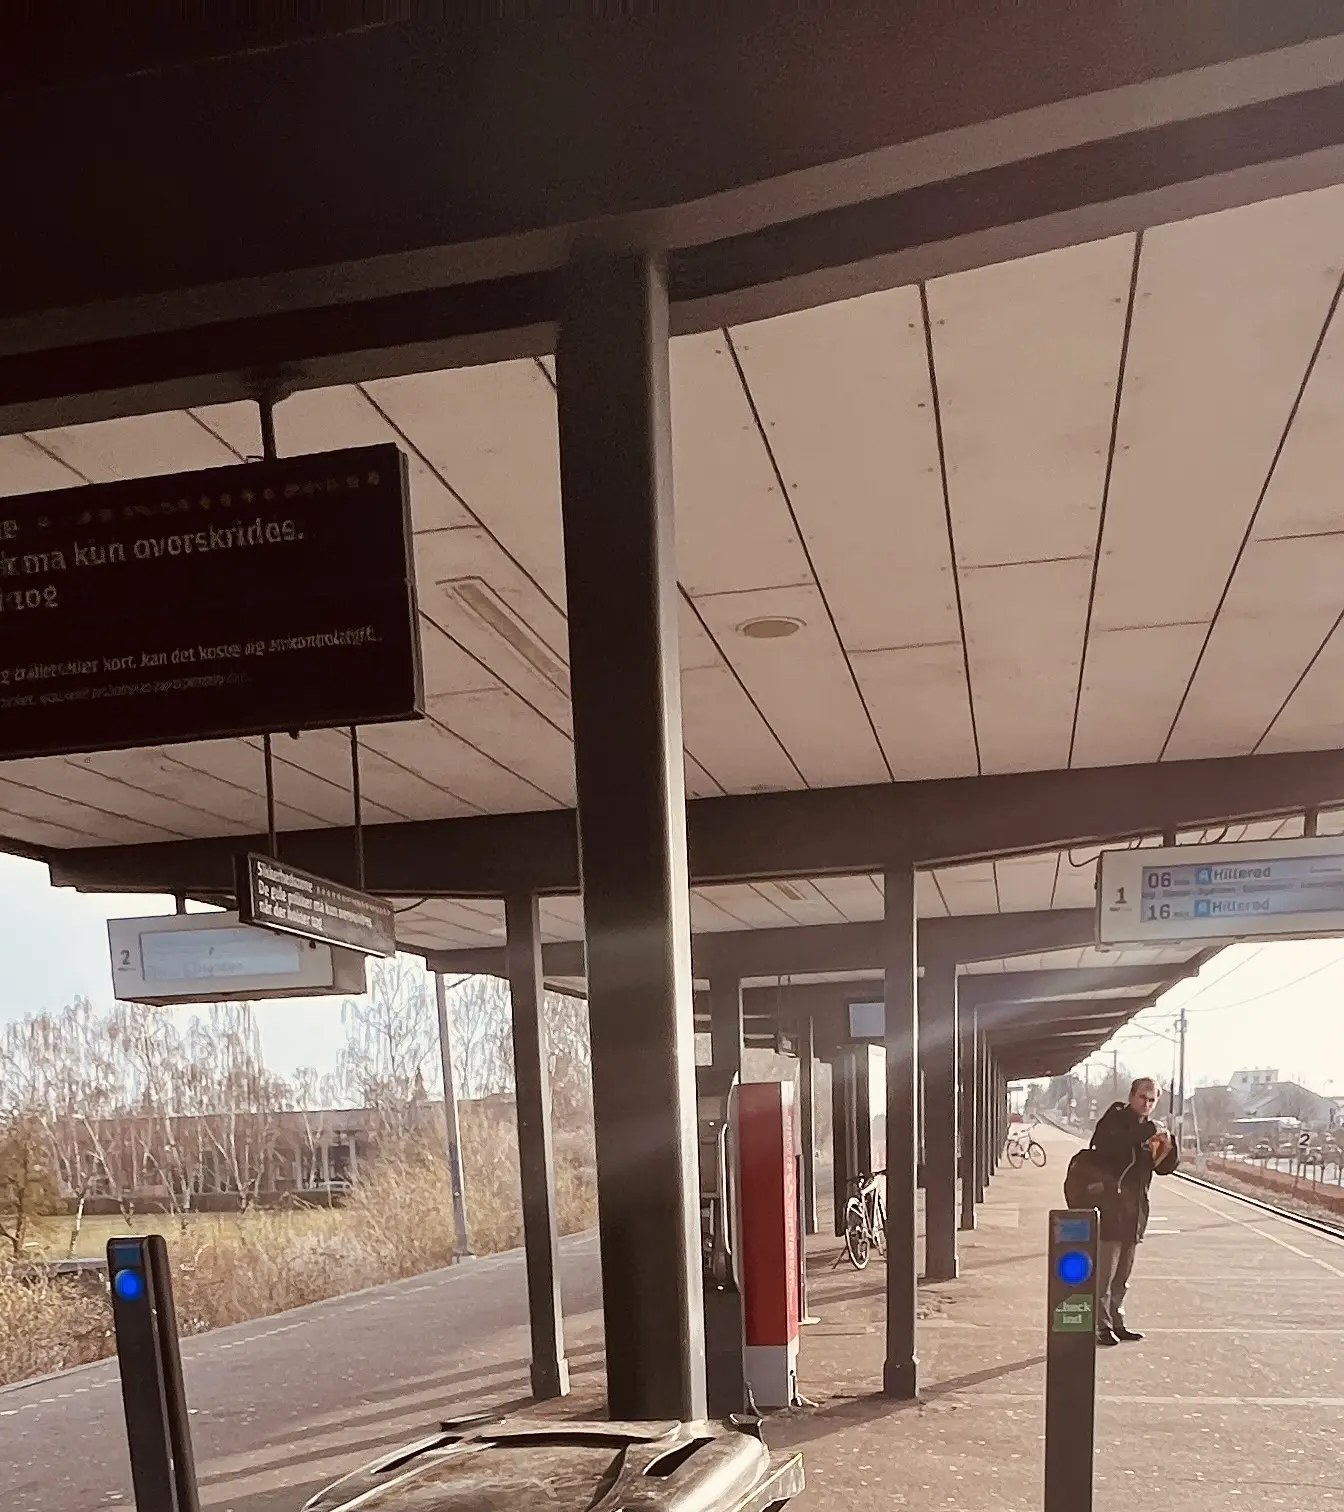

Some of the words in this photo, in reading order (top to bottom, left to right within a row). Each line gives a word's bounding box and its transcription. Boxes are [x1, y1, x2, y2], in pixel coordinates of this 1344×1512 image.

[1147, 872, 1172, 889] 06
[1116, 888, 1127, 903] 1
[1147, 904, 1171, 920] 16
[120, 950, 131, 965] 2
[1299, 1133, 1311, 1146] 2
